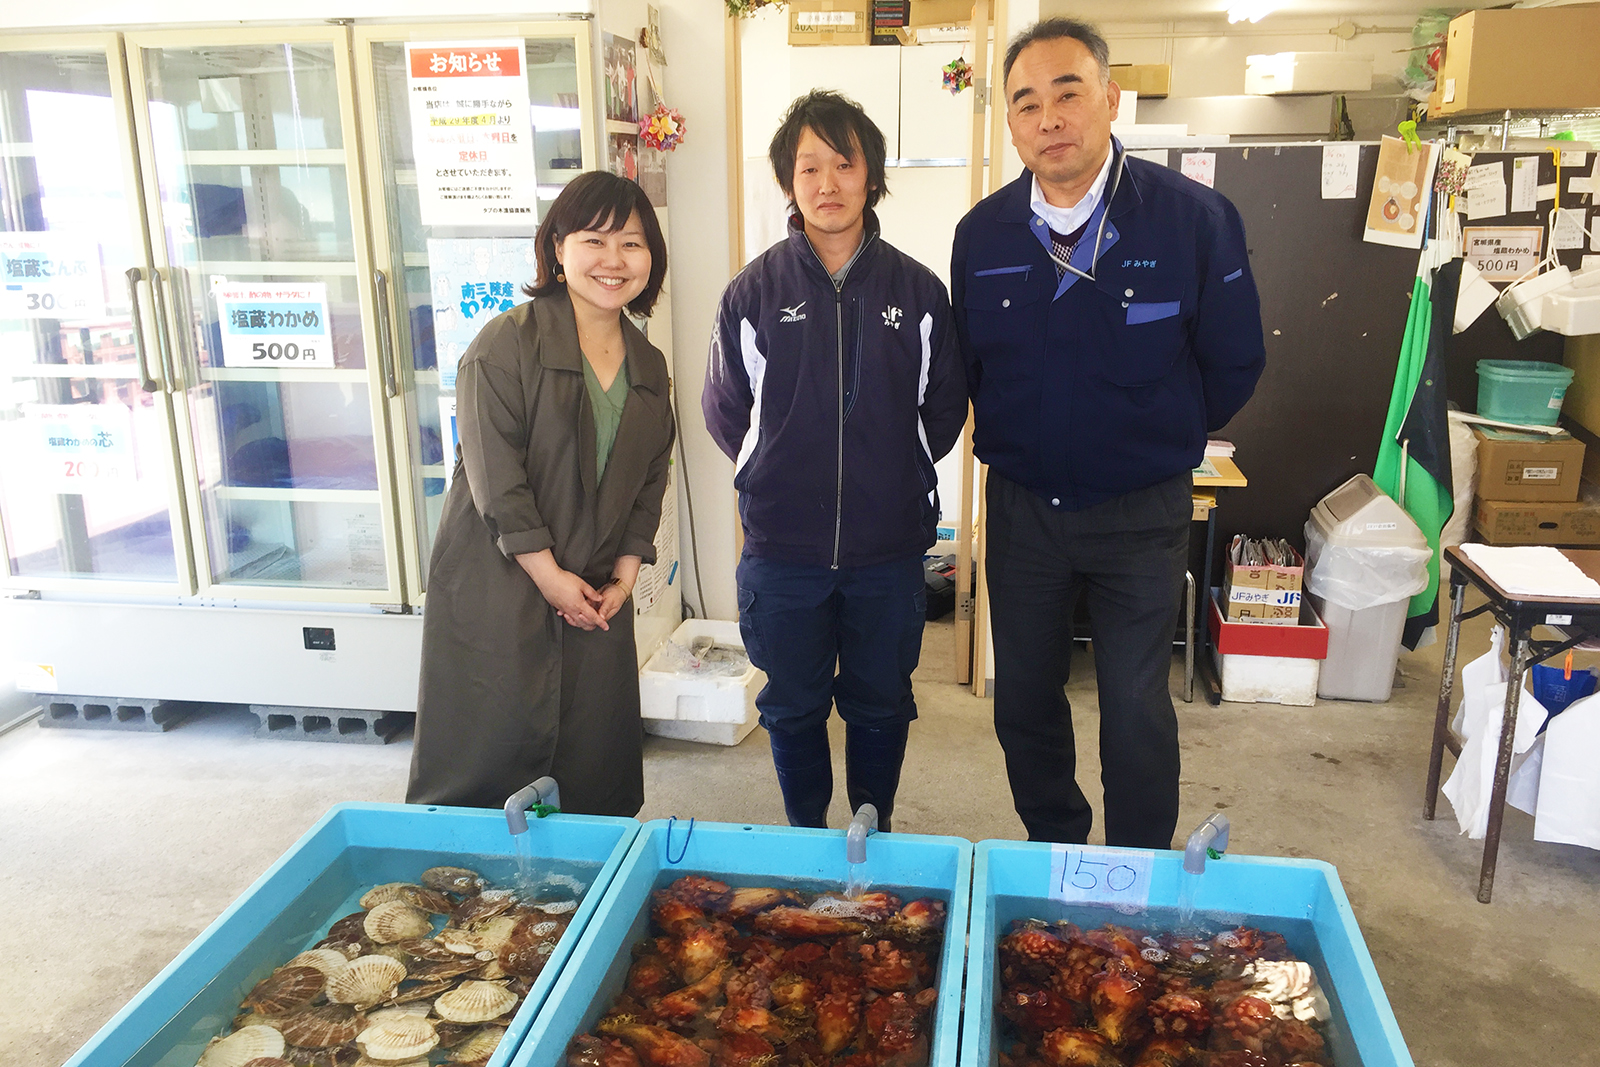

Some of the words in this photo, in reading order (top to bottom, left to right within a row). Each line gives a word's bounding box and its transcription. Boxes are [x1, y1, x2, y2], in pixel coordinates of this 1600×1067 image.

[429, 52, 502, 74] お知らせ
[459, 151, 487, 161] 定休日
[436, 168, 512, 177] とさせていただきます。
[461, 281, 514, 300] 南三陸産
[231, 309, 320, 329] 塩蔵わかめ
[252, 342, 316, 361] 500円
[1231, 592, 1270, 602] JFみやぎ
[1060, 850, 1137, 893] 150
